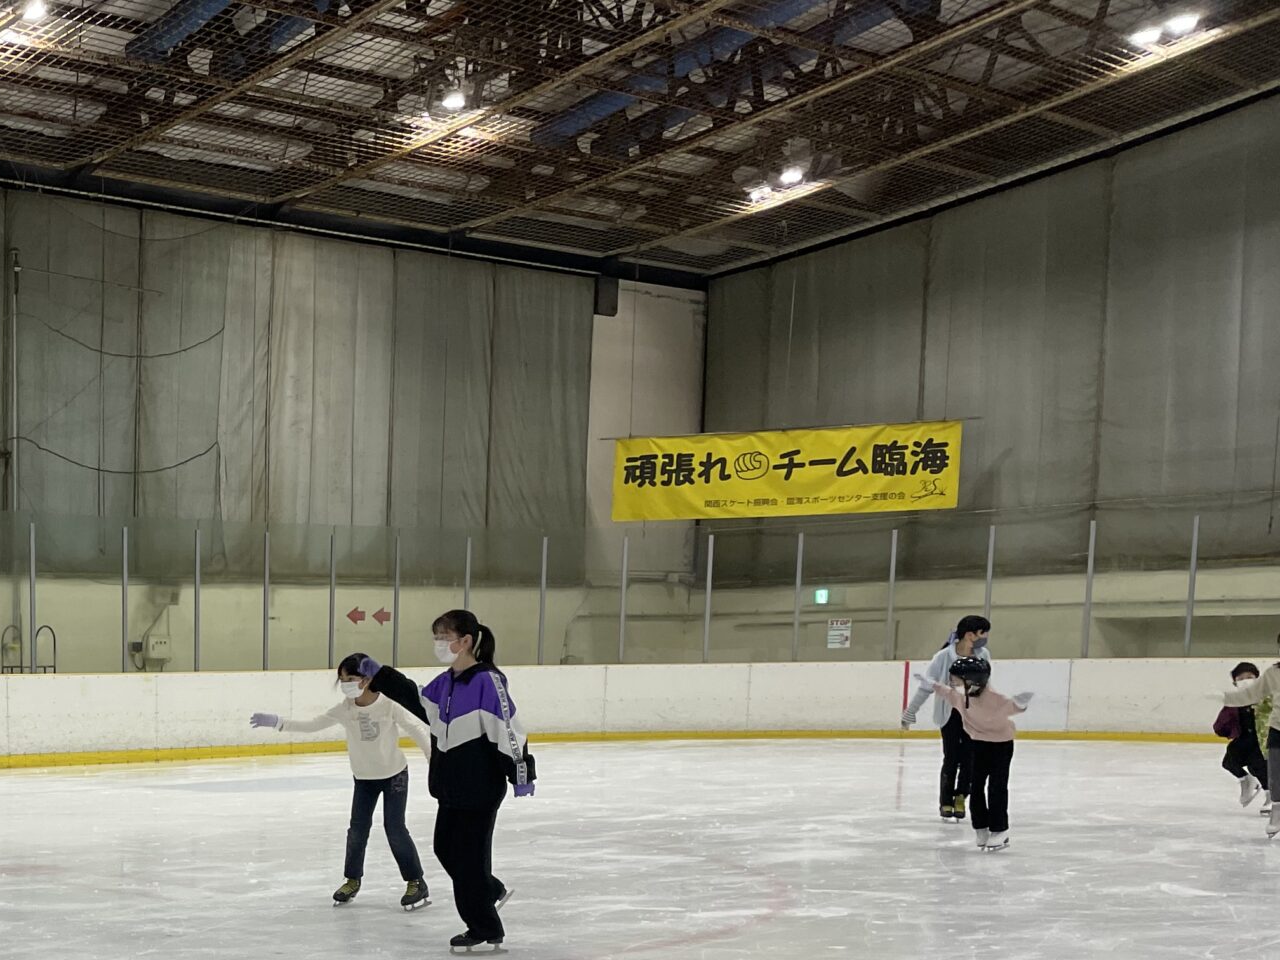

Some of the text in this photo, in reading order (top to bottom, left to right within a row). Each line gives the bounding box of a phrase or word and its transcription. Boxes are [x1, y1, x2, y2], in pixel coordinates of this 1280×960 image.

[623, 437, 950, 488] 頑張れ チーム臨海
